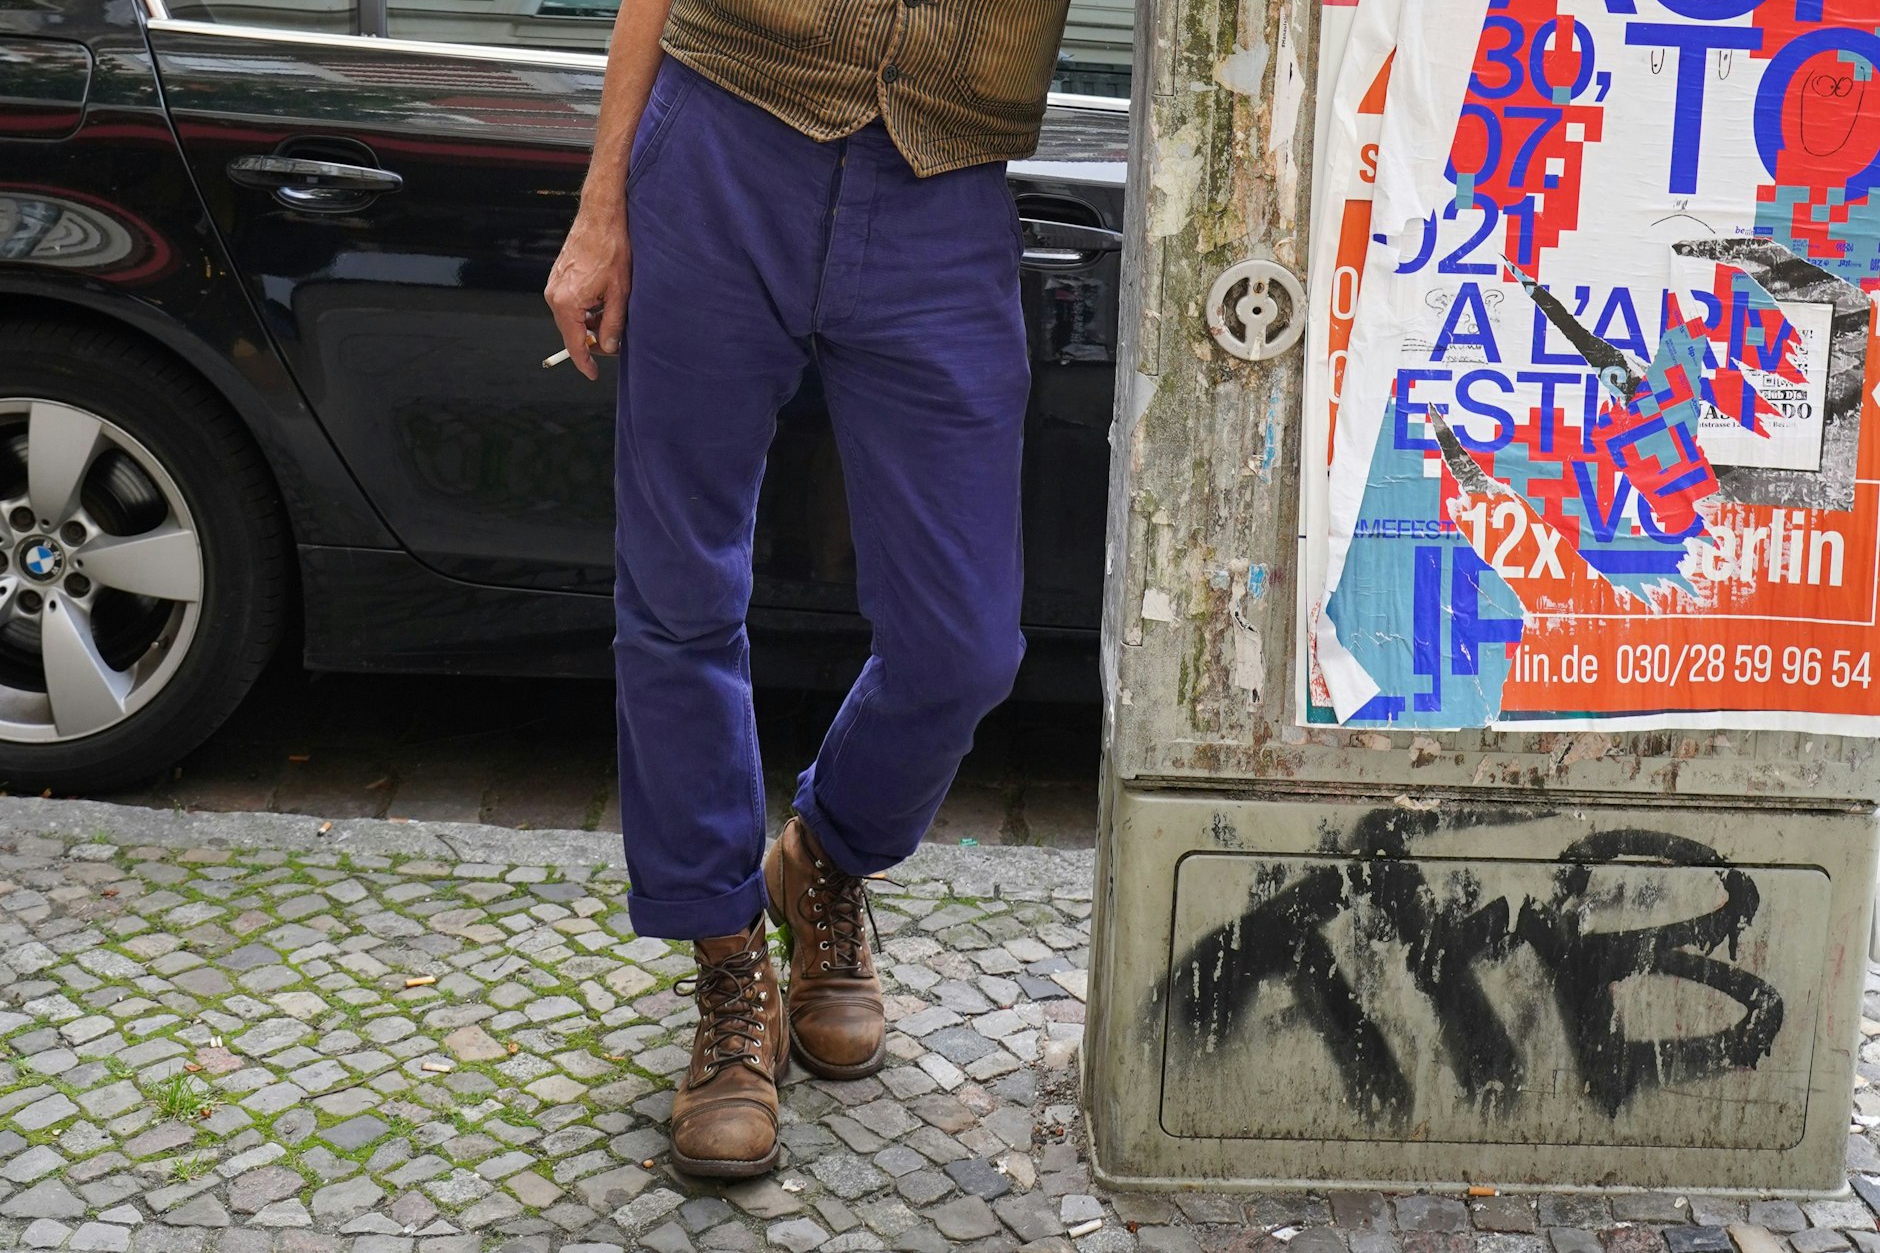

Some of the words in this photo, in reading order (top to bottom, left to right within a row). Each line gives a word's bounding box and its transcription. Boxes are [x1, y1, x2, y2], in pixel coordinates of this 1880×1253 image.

[1429, 281, 1502, 364] A
[42, 539, 62, 575] BMW
[1615, 643, 1726, 688] 030/28
[1733, 645, 1773, 683] 59
[1781, 647, 1823, 687] 96
[1831, 650, 1872, 690] 54
